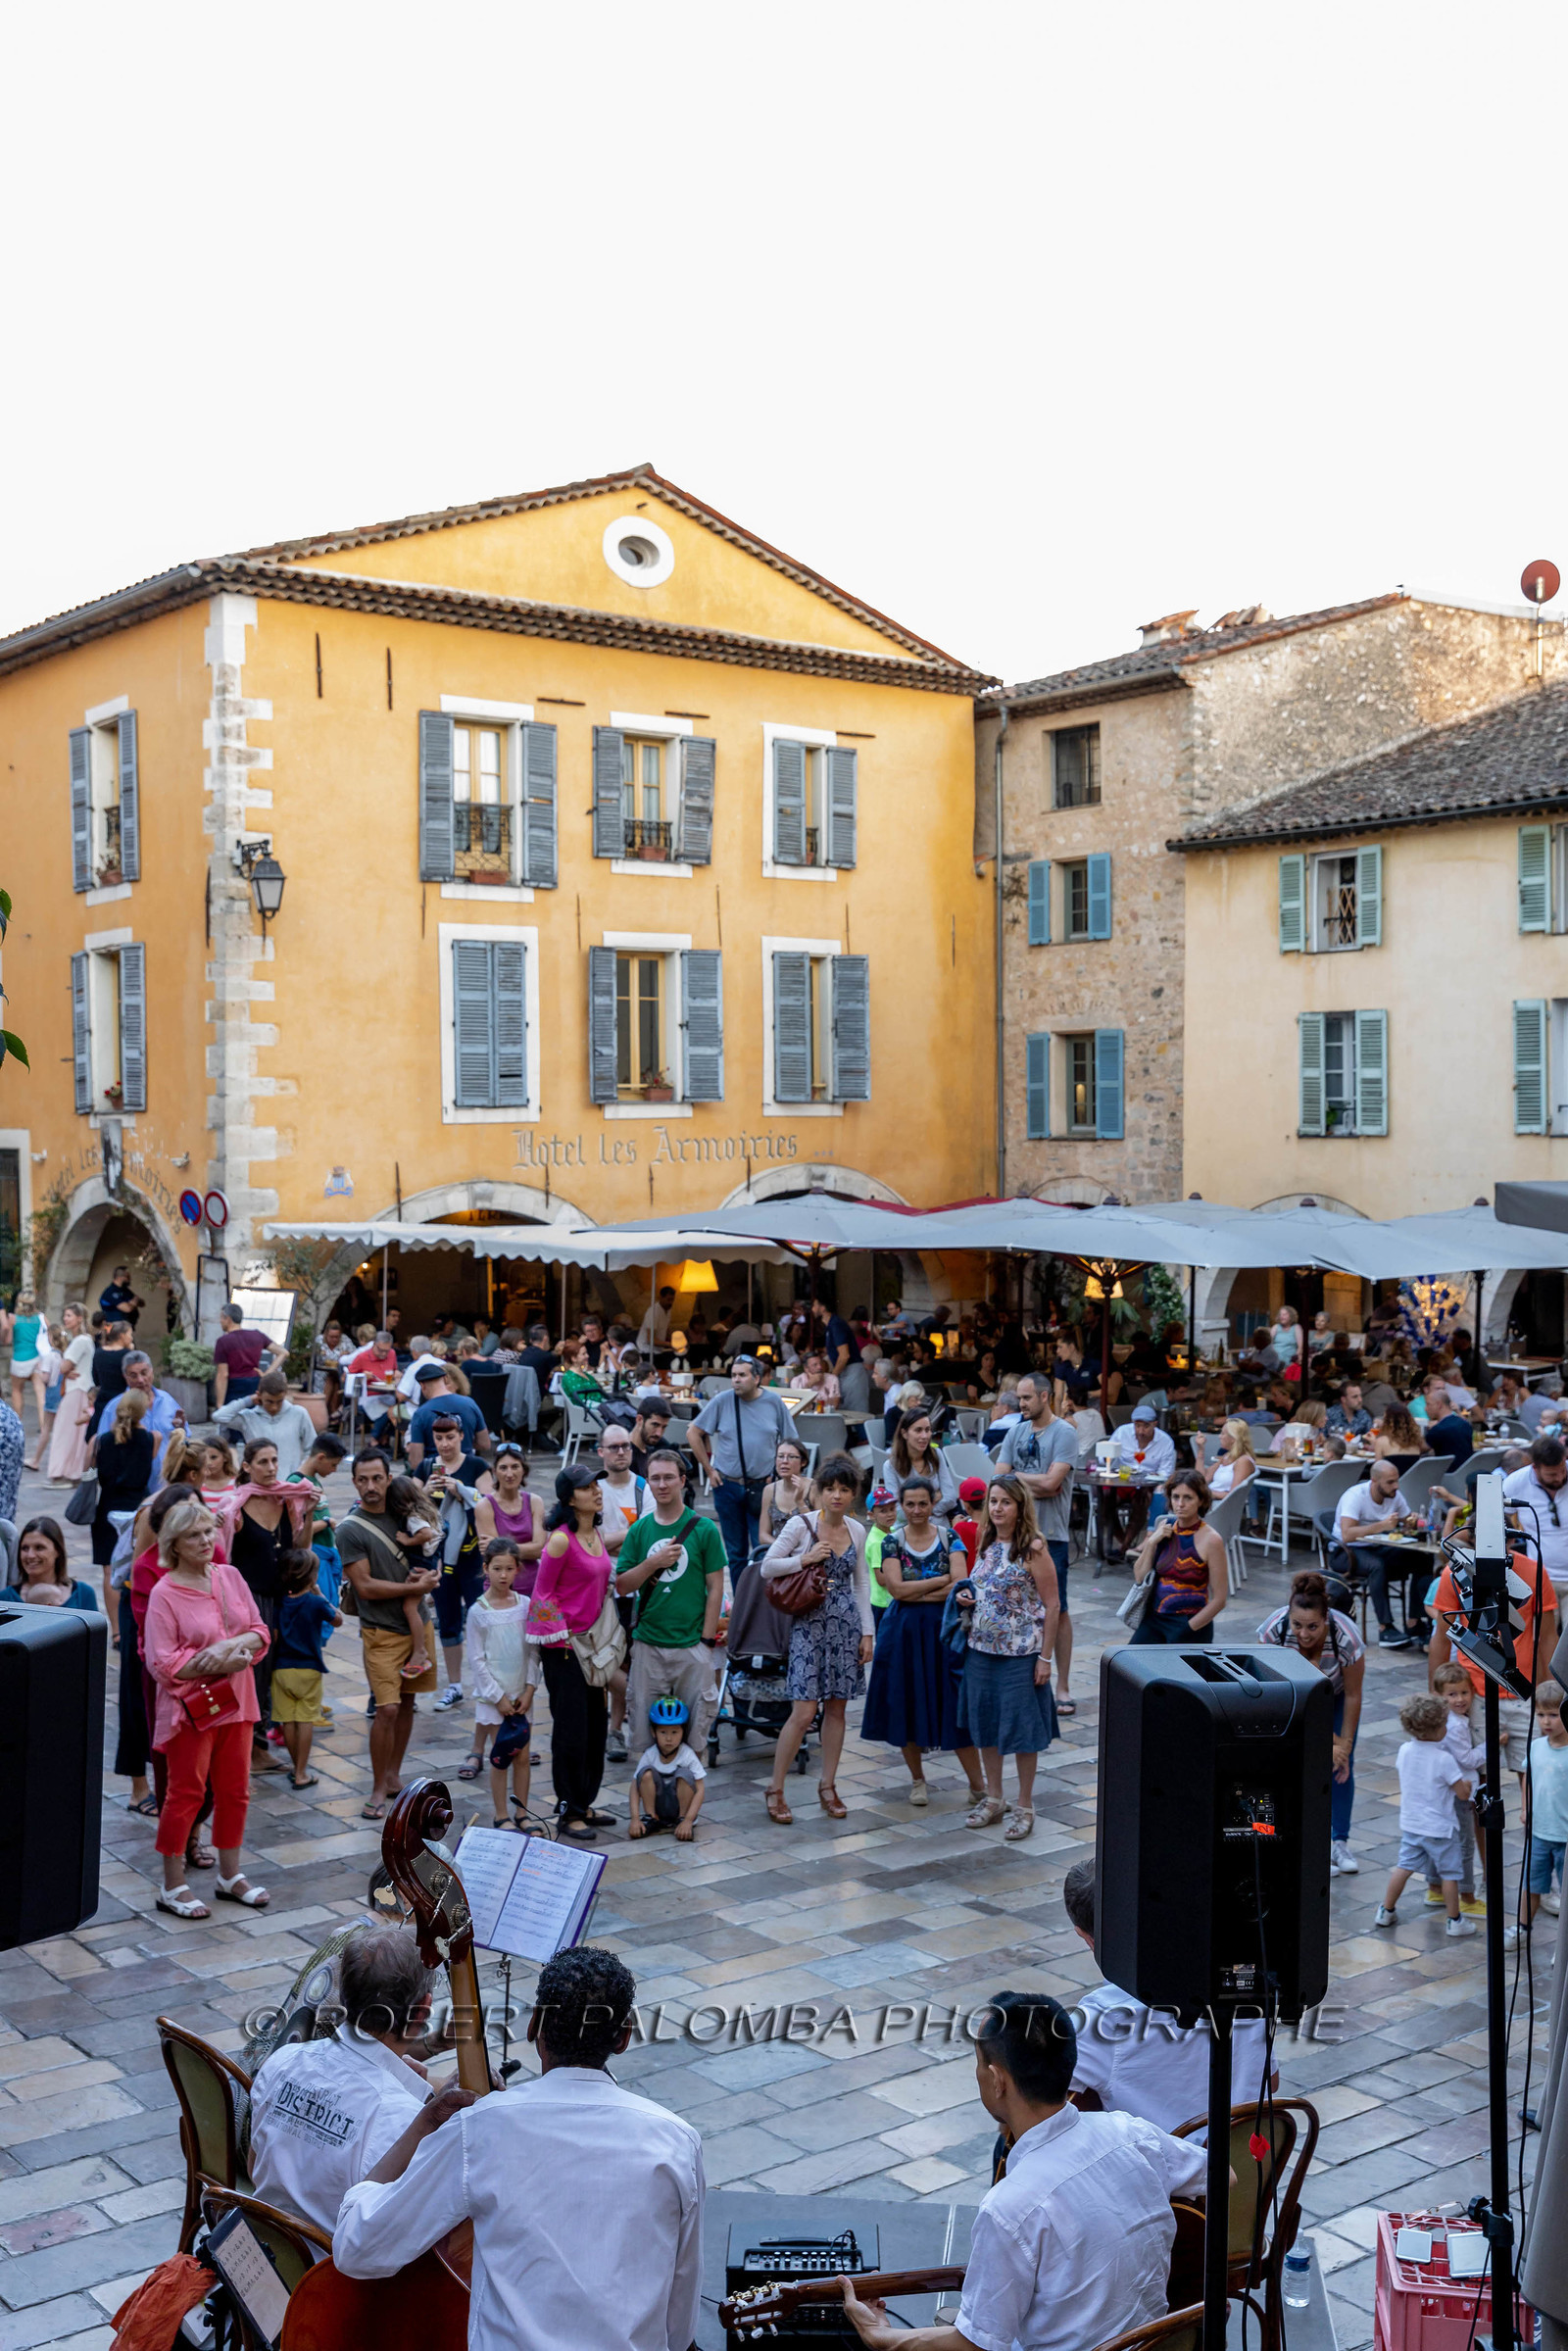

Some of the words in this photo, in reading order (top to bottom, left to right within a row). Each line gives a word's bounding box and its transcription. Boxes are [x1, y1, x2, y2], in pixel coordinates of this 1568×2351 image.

[599, 1133, 637, 1166] les
[651, 1126, 798, 1165] Armoiries
[276, 2081, 355, 2135] DISTRICT
